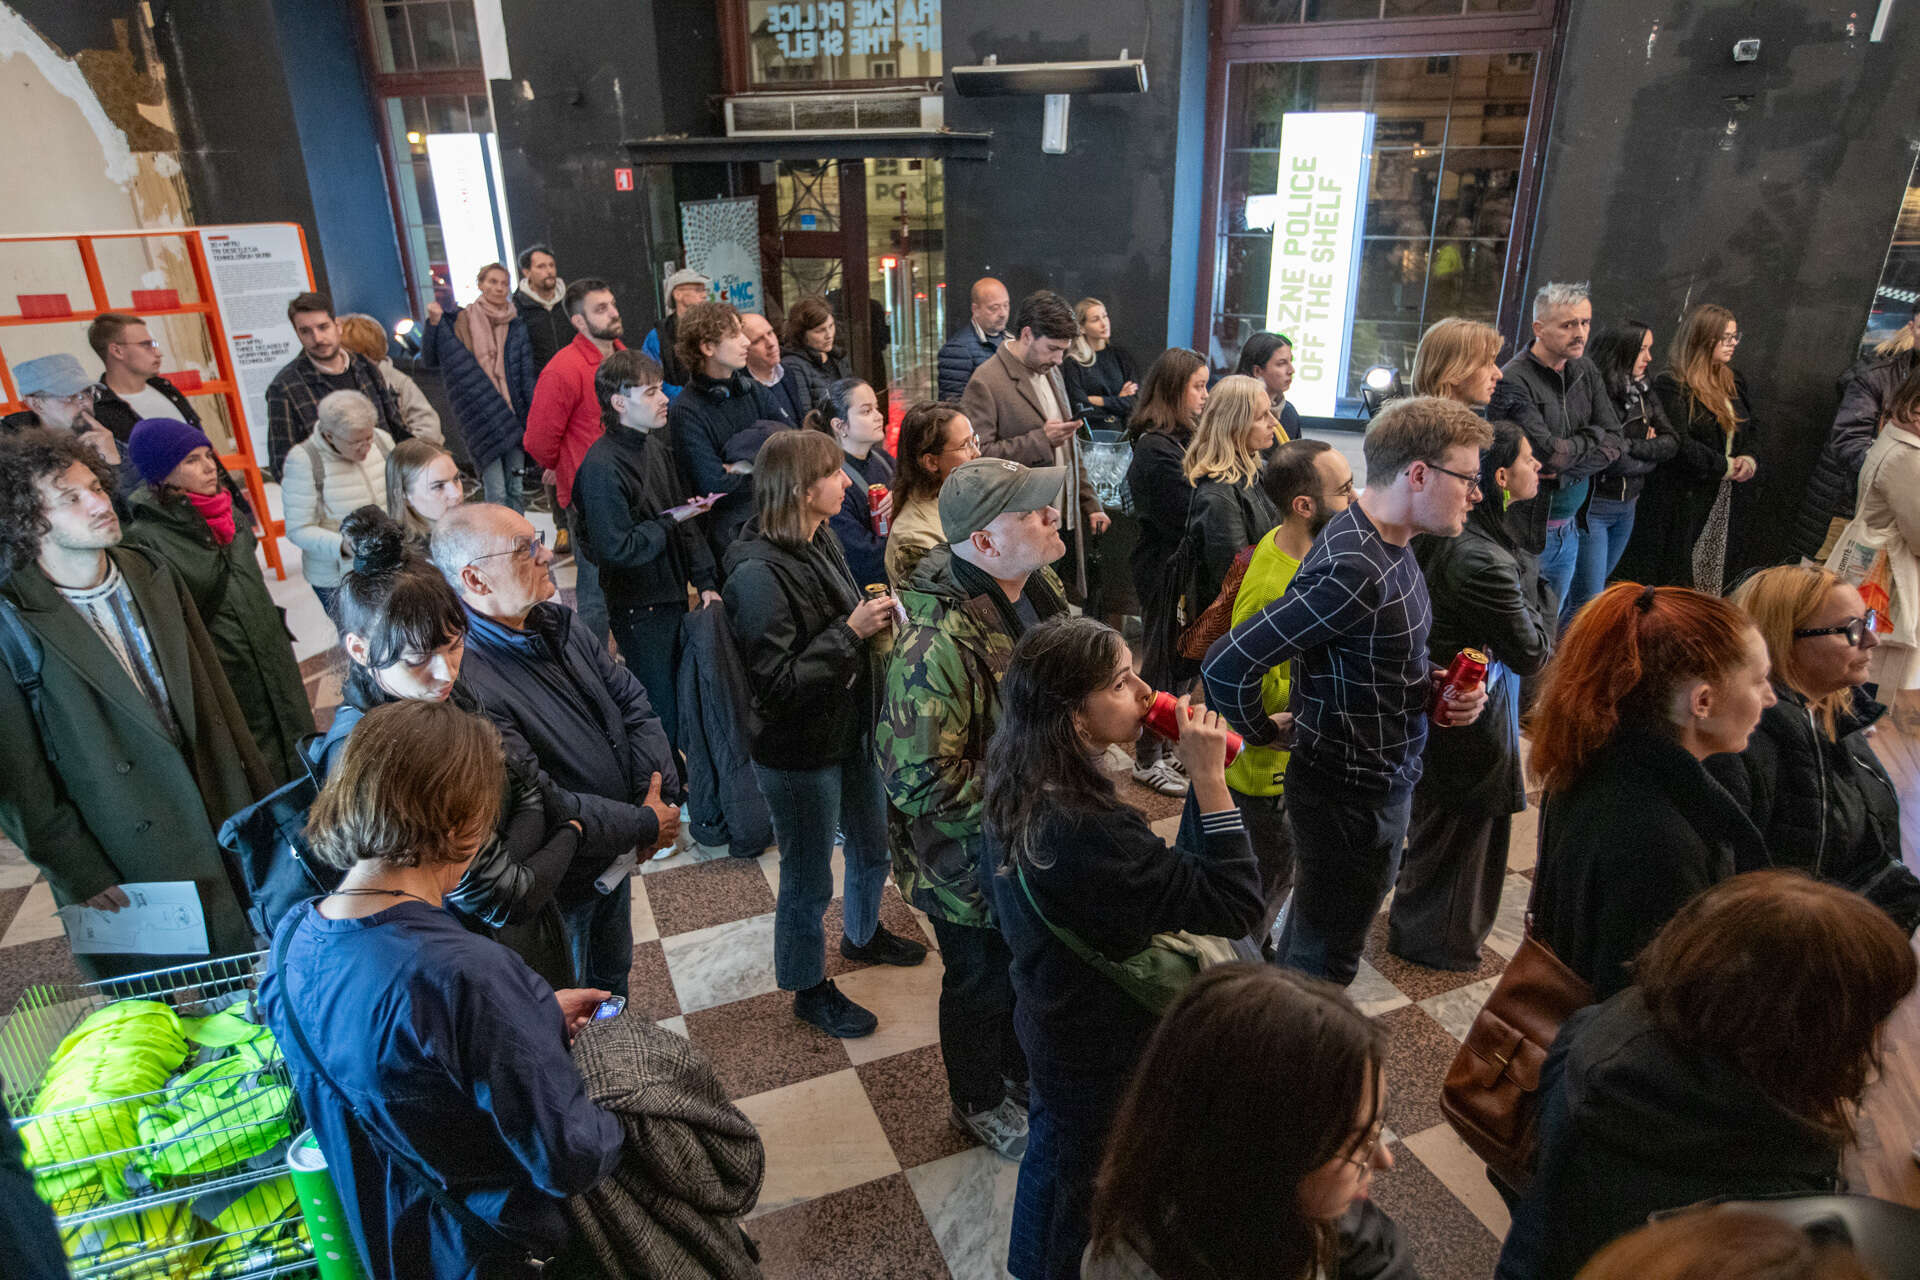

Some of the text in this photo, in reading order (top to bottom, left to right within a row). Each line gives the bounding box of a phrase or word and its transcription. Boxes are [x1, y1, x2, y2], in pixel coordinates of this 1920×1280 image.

[1277, 156, 1317, 351] AZNE POLICE
[1300, 176, 1342, 381] OFF THE SHELF
